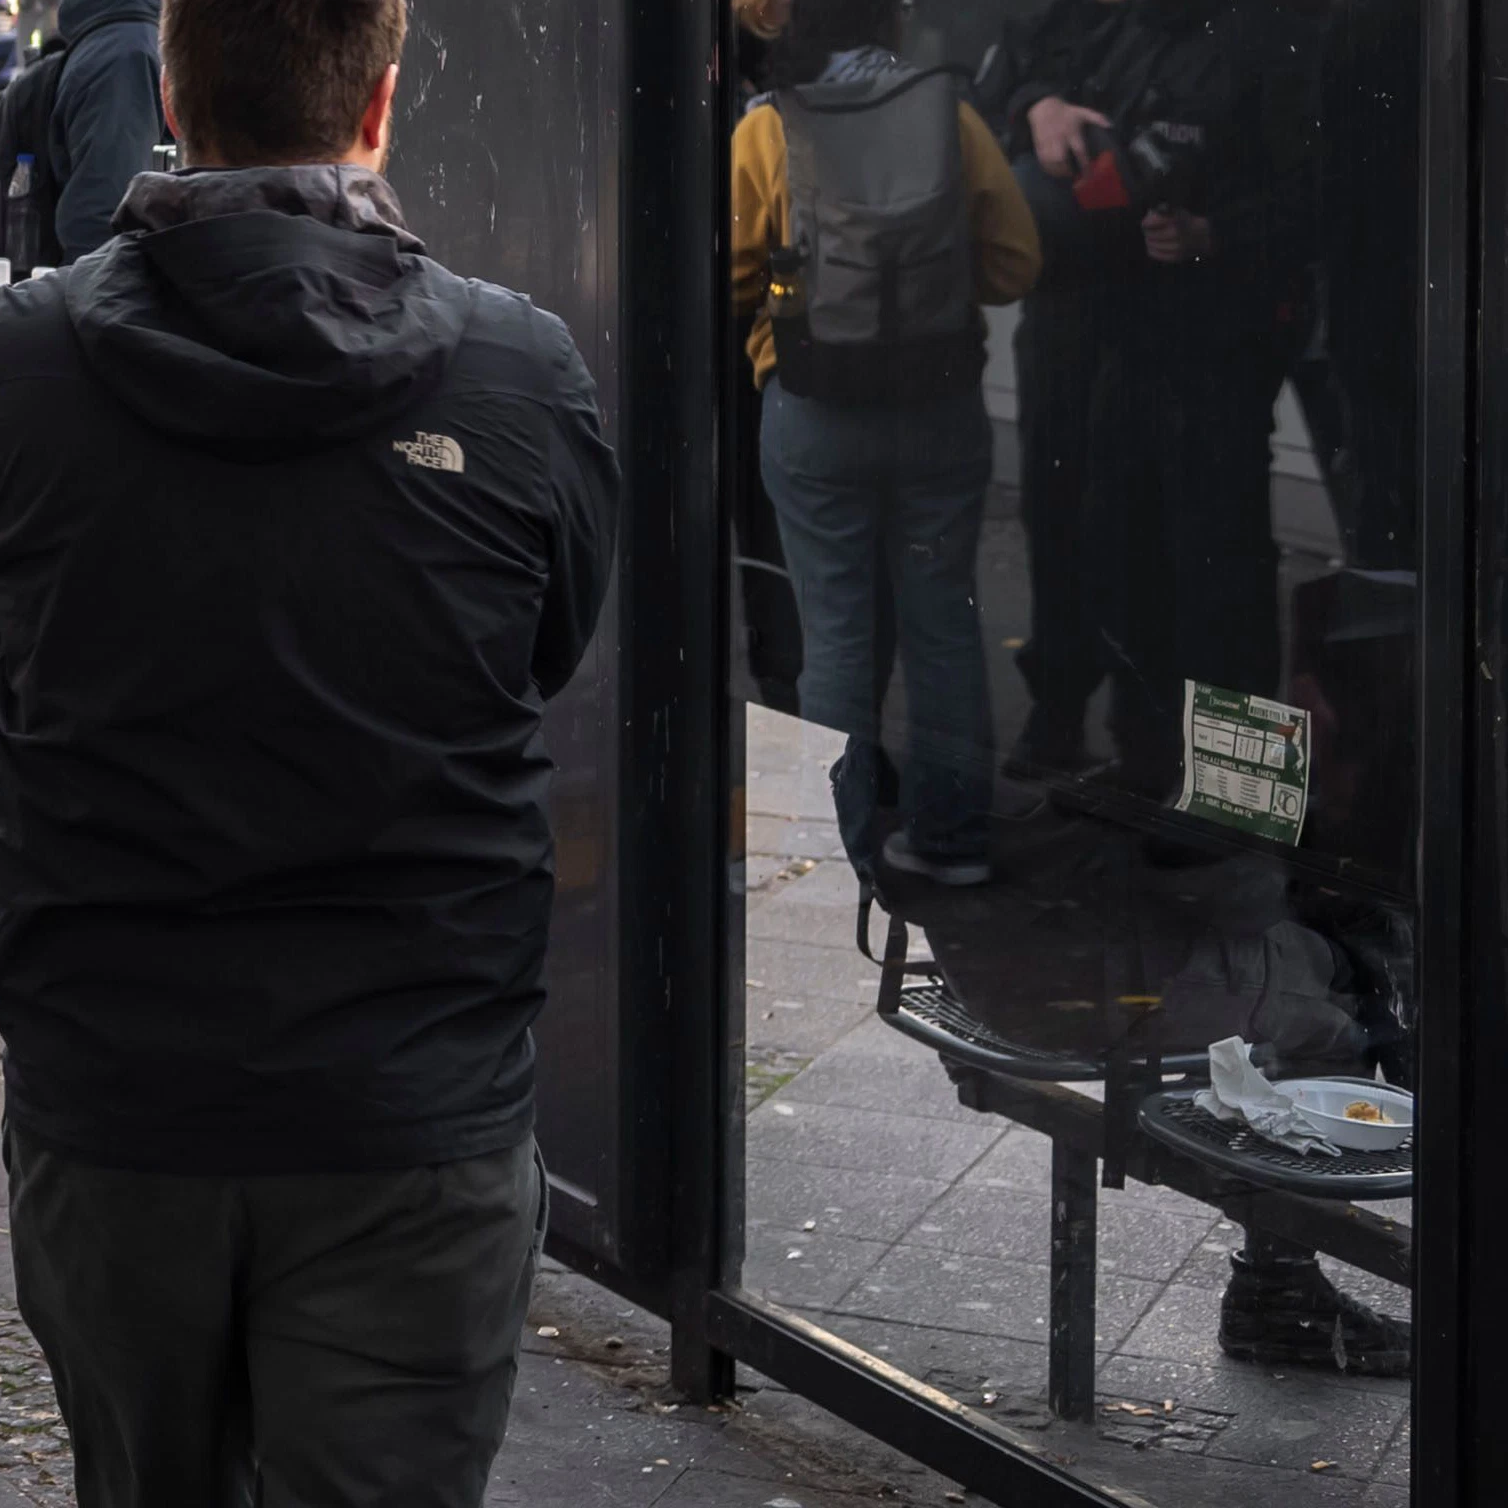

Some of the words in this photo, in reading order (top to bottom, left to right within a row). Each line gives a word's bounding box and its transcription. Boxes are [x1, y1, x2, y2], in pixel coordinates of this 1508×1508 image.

[415, 431, 444, 445] THE
[392, 440, 444, 459] NORTH
[406, 453, 444, 469] FACE
